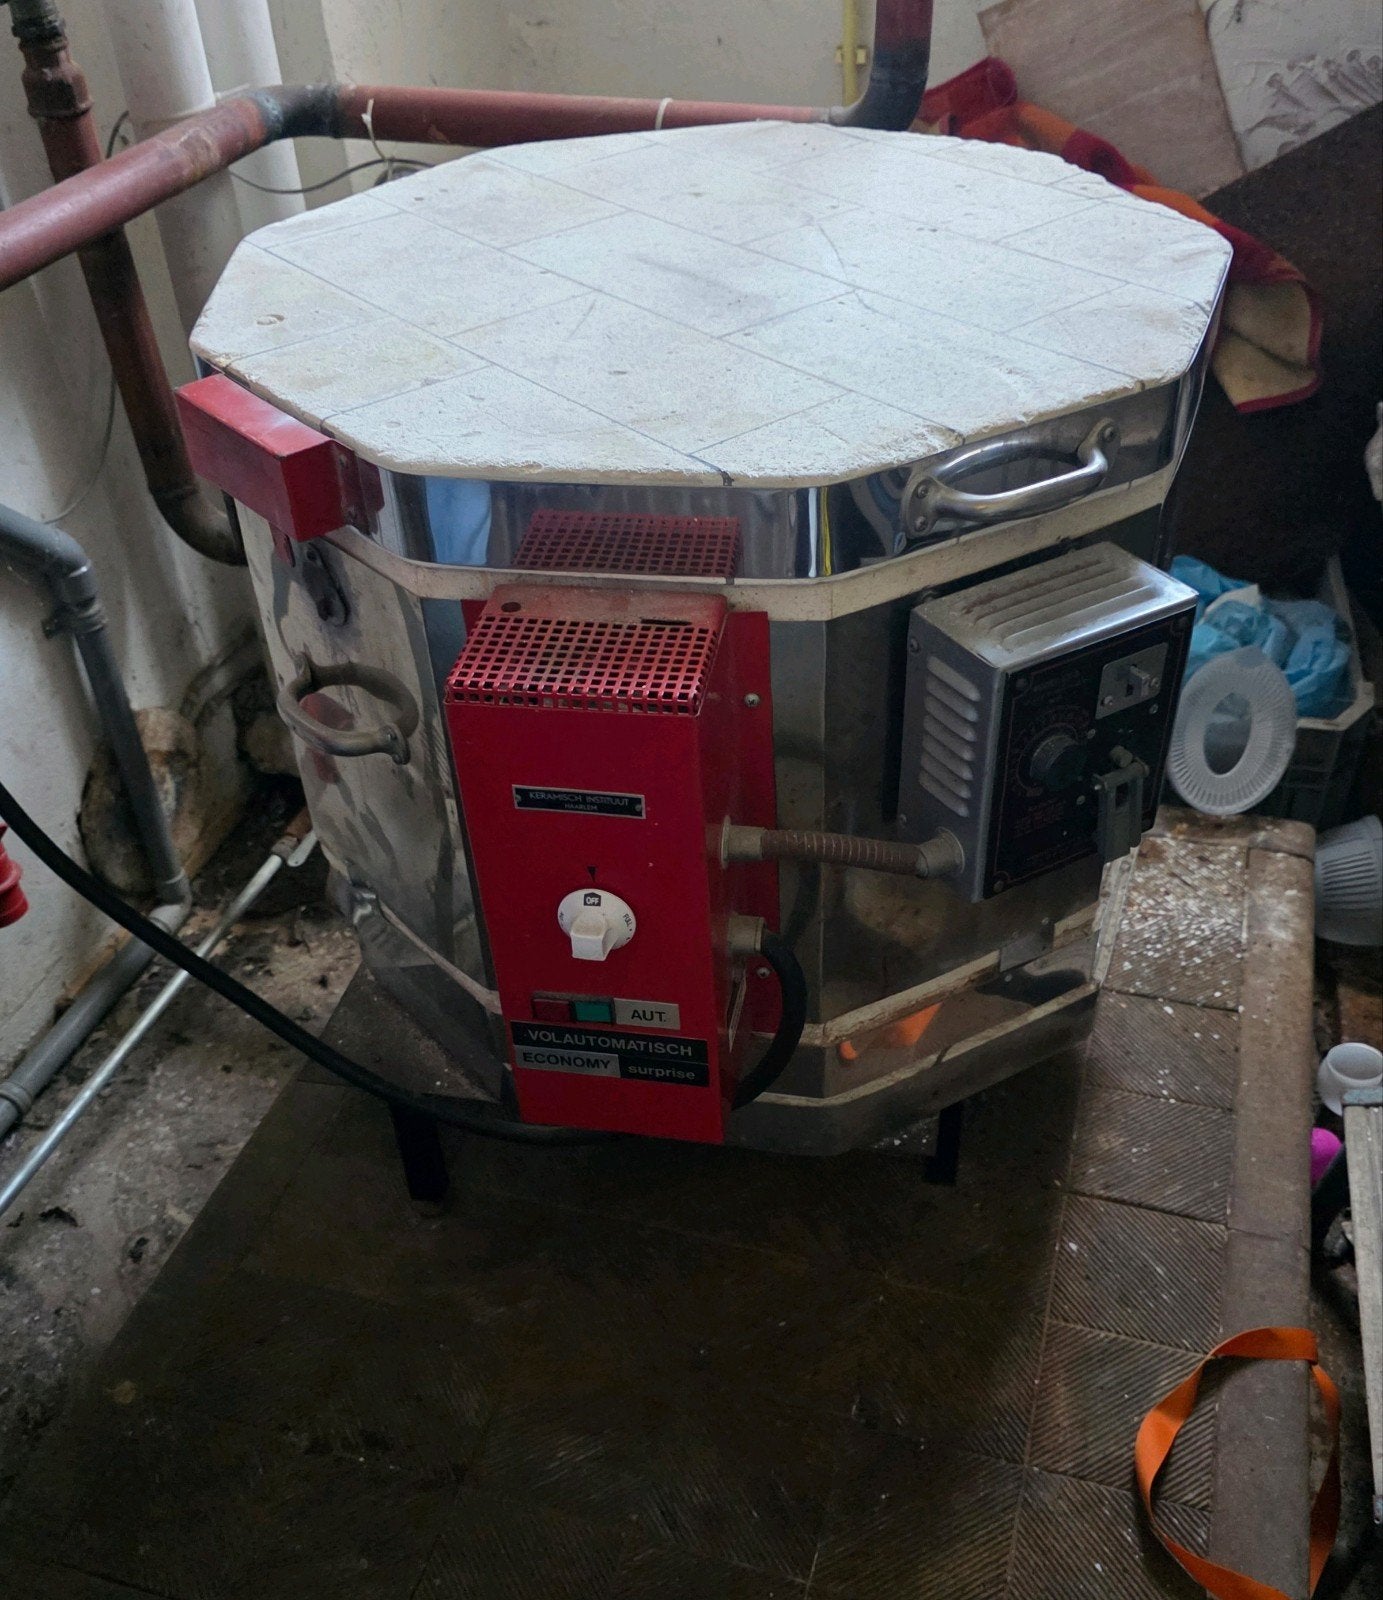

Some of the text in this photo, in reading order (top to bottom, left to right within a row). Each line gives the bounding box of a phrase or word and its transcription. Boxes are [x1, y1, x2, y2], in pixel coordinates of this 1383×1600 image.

[529, 791, 629, 806] KERAMISCH INSTITUUT
[585, 896, 600, 905] OFF
[630, 1009, 667, 1023] AUT.
[527, 1029, 693, 1057] VOLAUTOMATISCH
[523, 1052, 696, 1080] ECONOMY surprise
